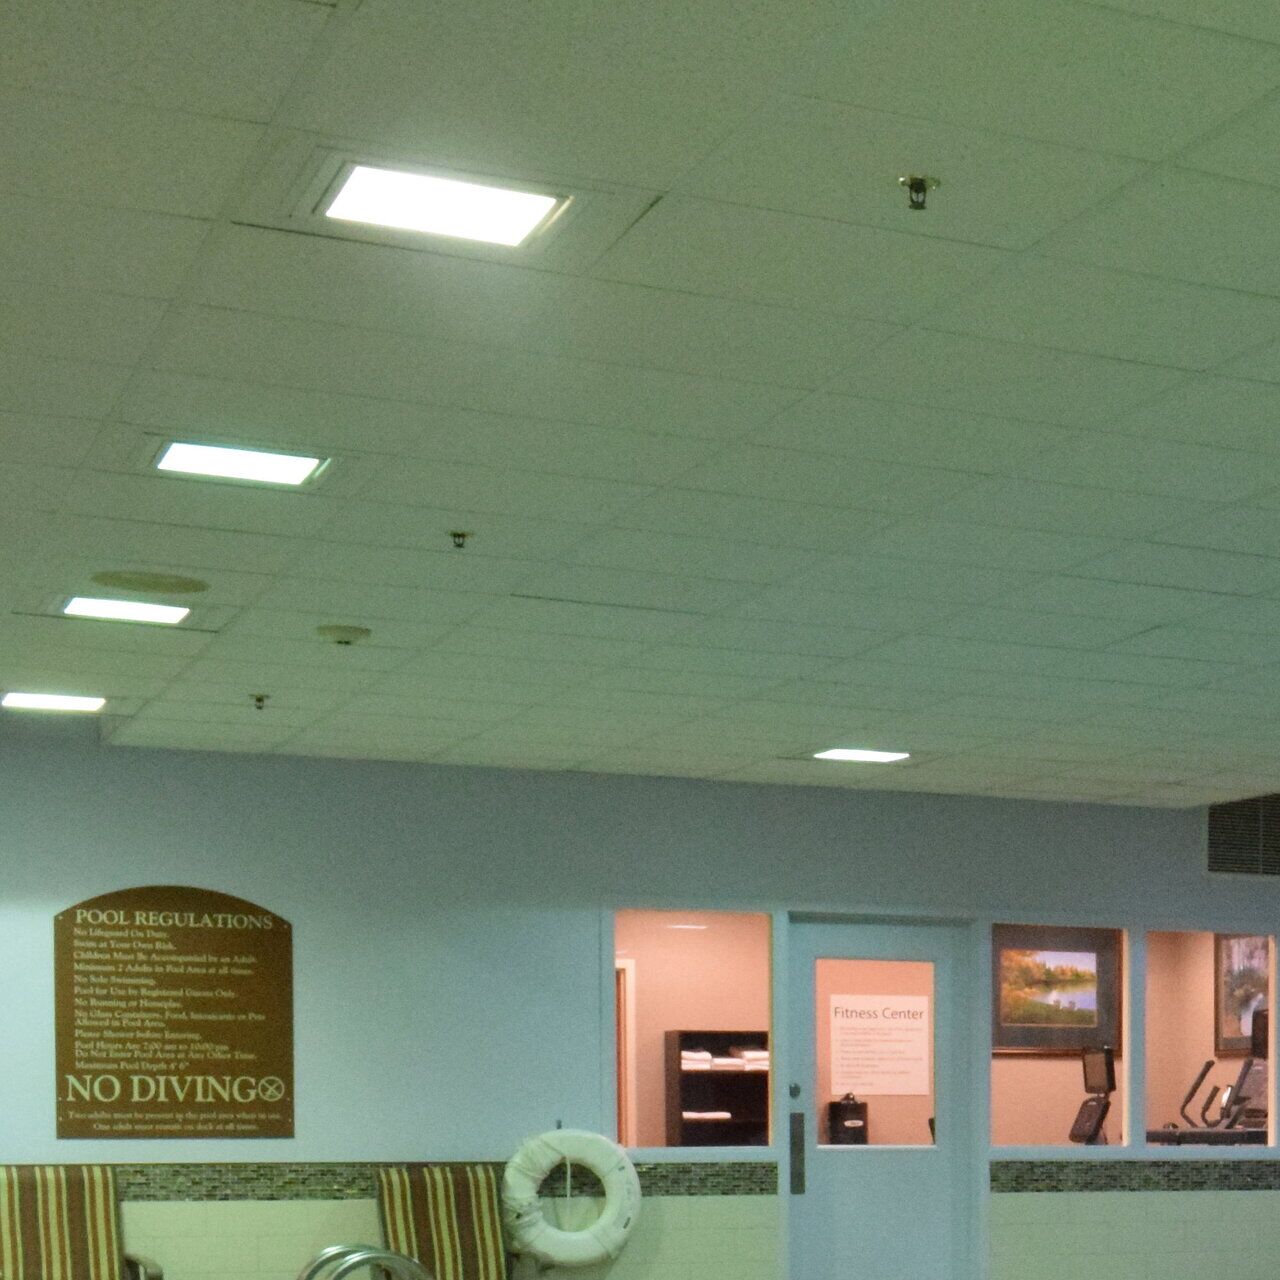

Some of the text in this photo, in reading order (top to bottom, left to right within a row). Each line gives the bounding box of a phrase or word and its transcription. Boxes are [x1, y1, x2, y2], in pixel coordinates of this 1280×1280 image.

[76, 909, 273, 929] POOL REGULATIONS
[74, 927, 88, 936] No
[834, 1006, 924, 1020] Fitness Center
[66, 1075, 257, 1103] NO DIVING
